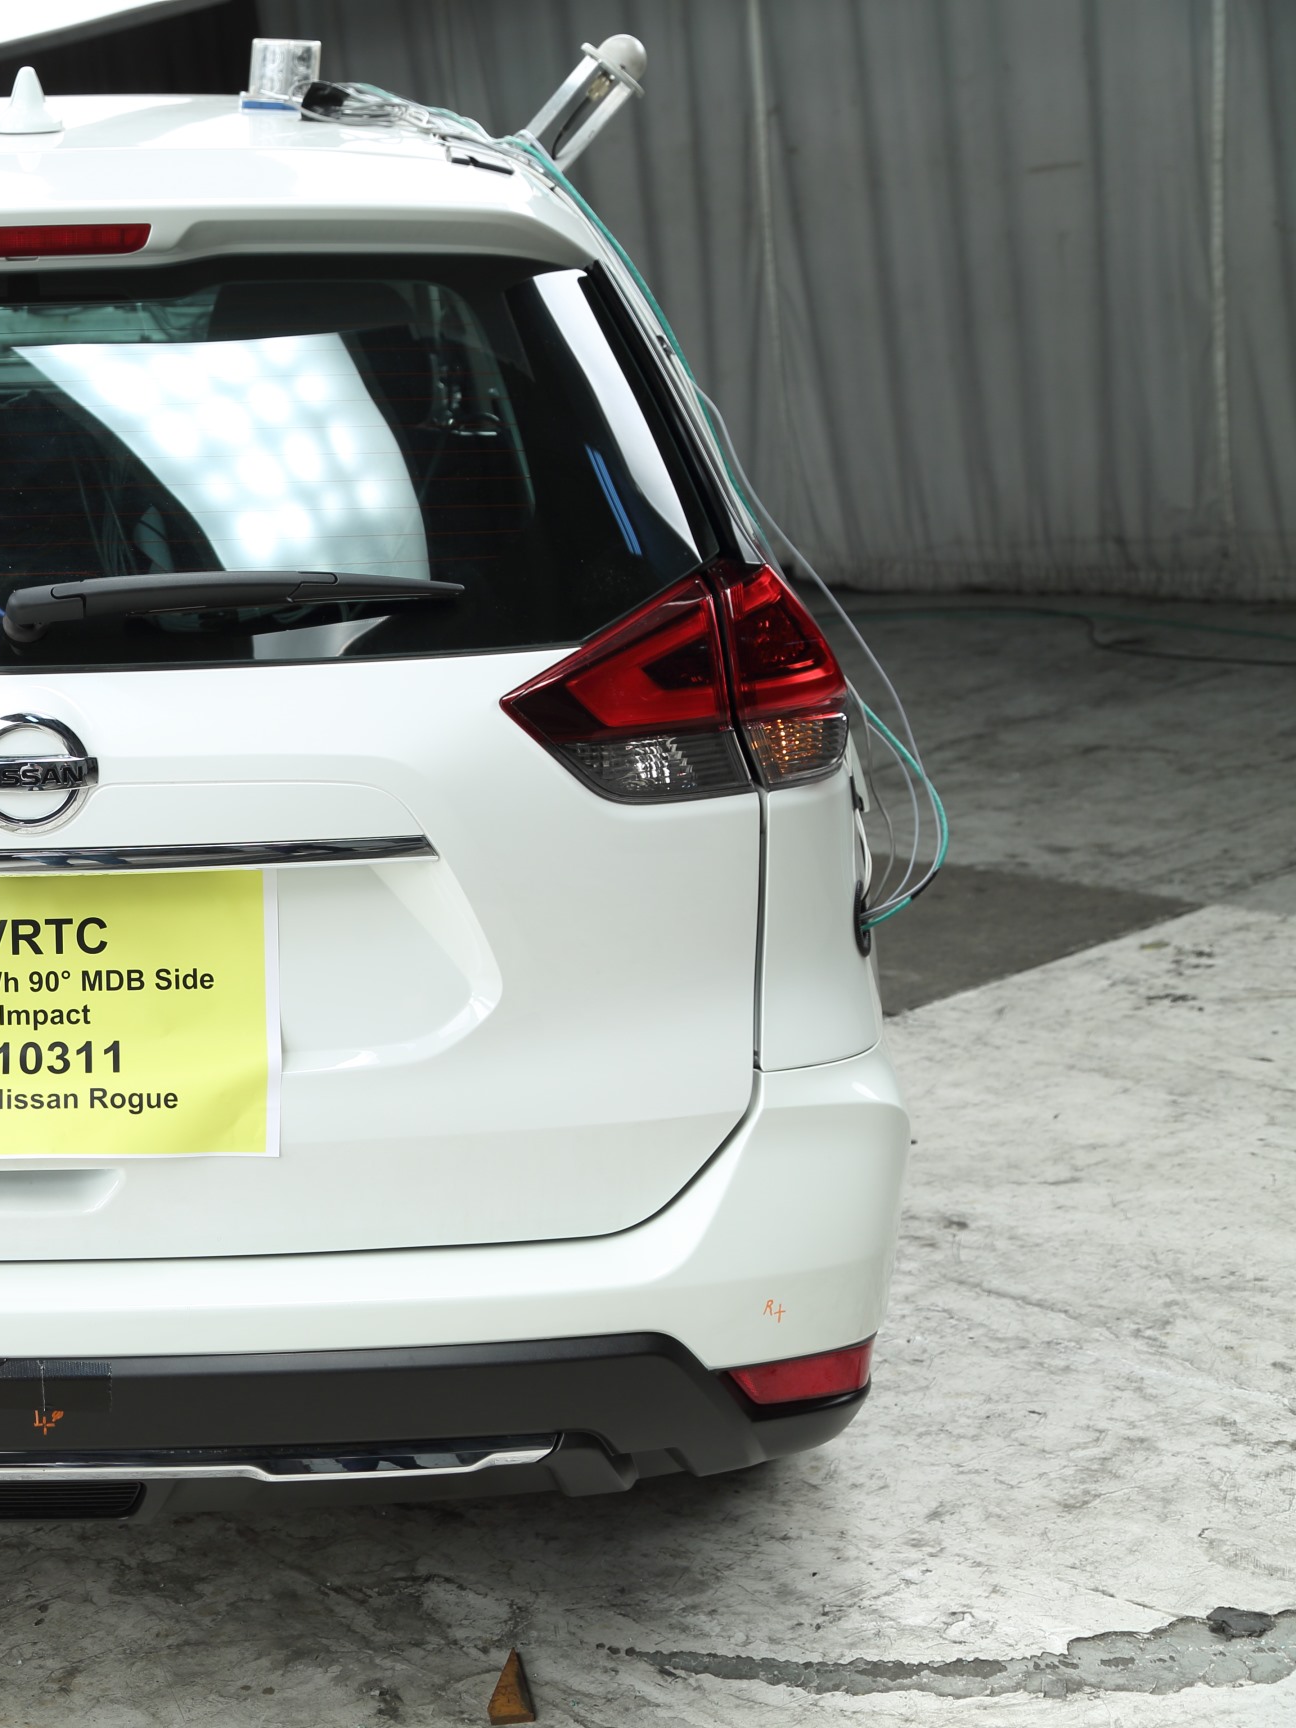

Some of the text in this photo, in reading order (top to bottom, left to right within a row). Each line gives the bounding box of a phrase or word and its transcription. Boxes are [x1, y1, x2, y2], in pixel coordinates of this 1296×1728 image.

[28, 970, 71, 993] 90°
[81, 969, 145, 992] MDB
[155, 967, 214, 991] Side
[0, 1004, 91, 1031] Impact
[89, 1087, 178, 1115] Rogue
